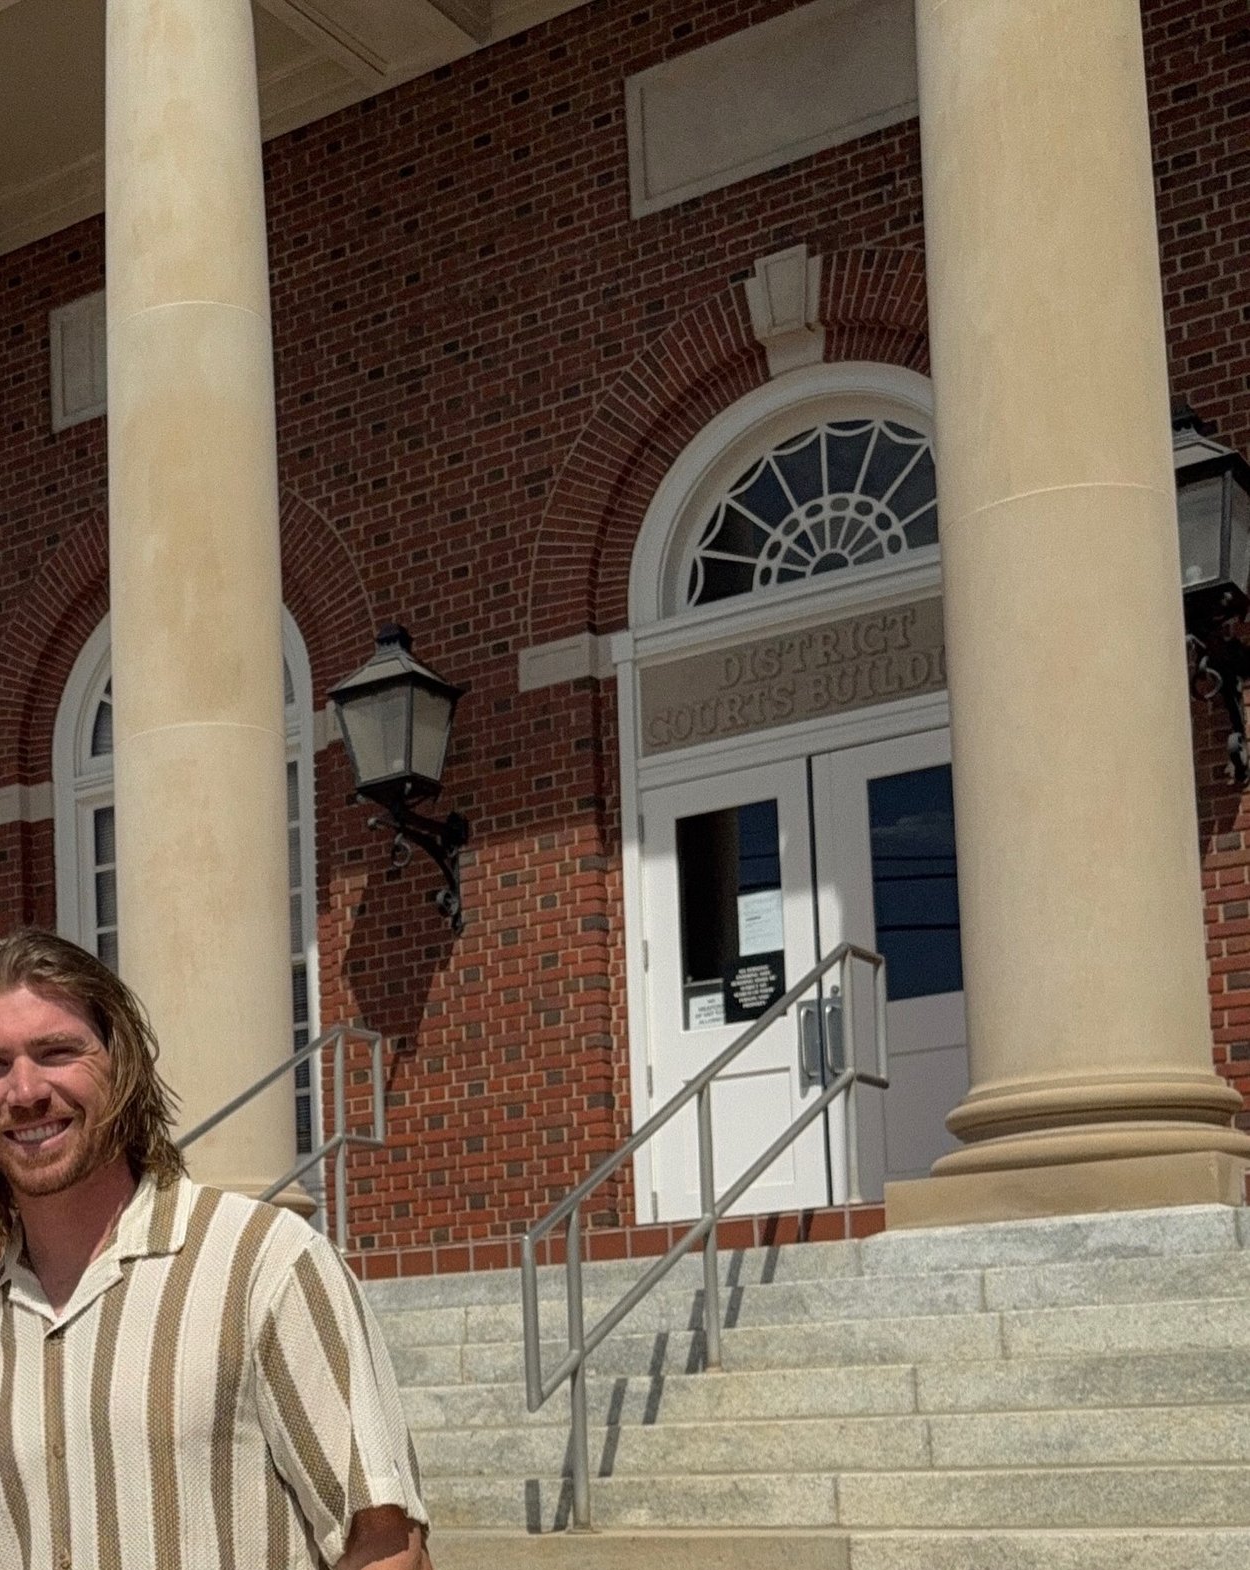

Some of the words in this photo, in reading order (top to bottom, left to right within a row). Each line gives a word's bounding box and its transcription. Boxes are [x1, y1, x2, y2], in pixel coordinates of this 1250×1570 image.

[718, 607, 916, 691] DISTRICT
[646, 682, 798, 746] COURTS
[806, 646, 947, 713] BUILDI
